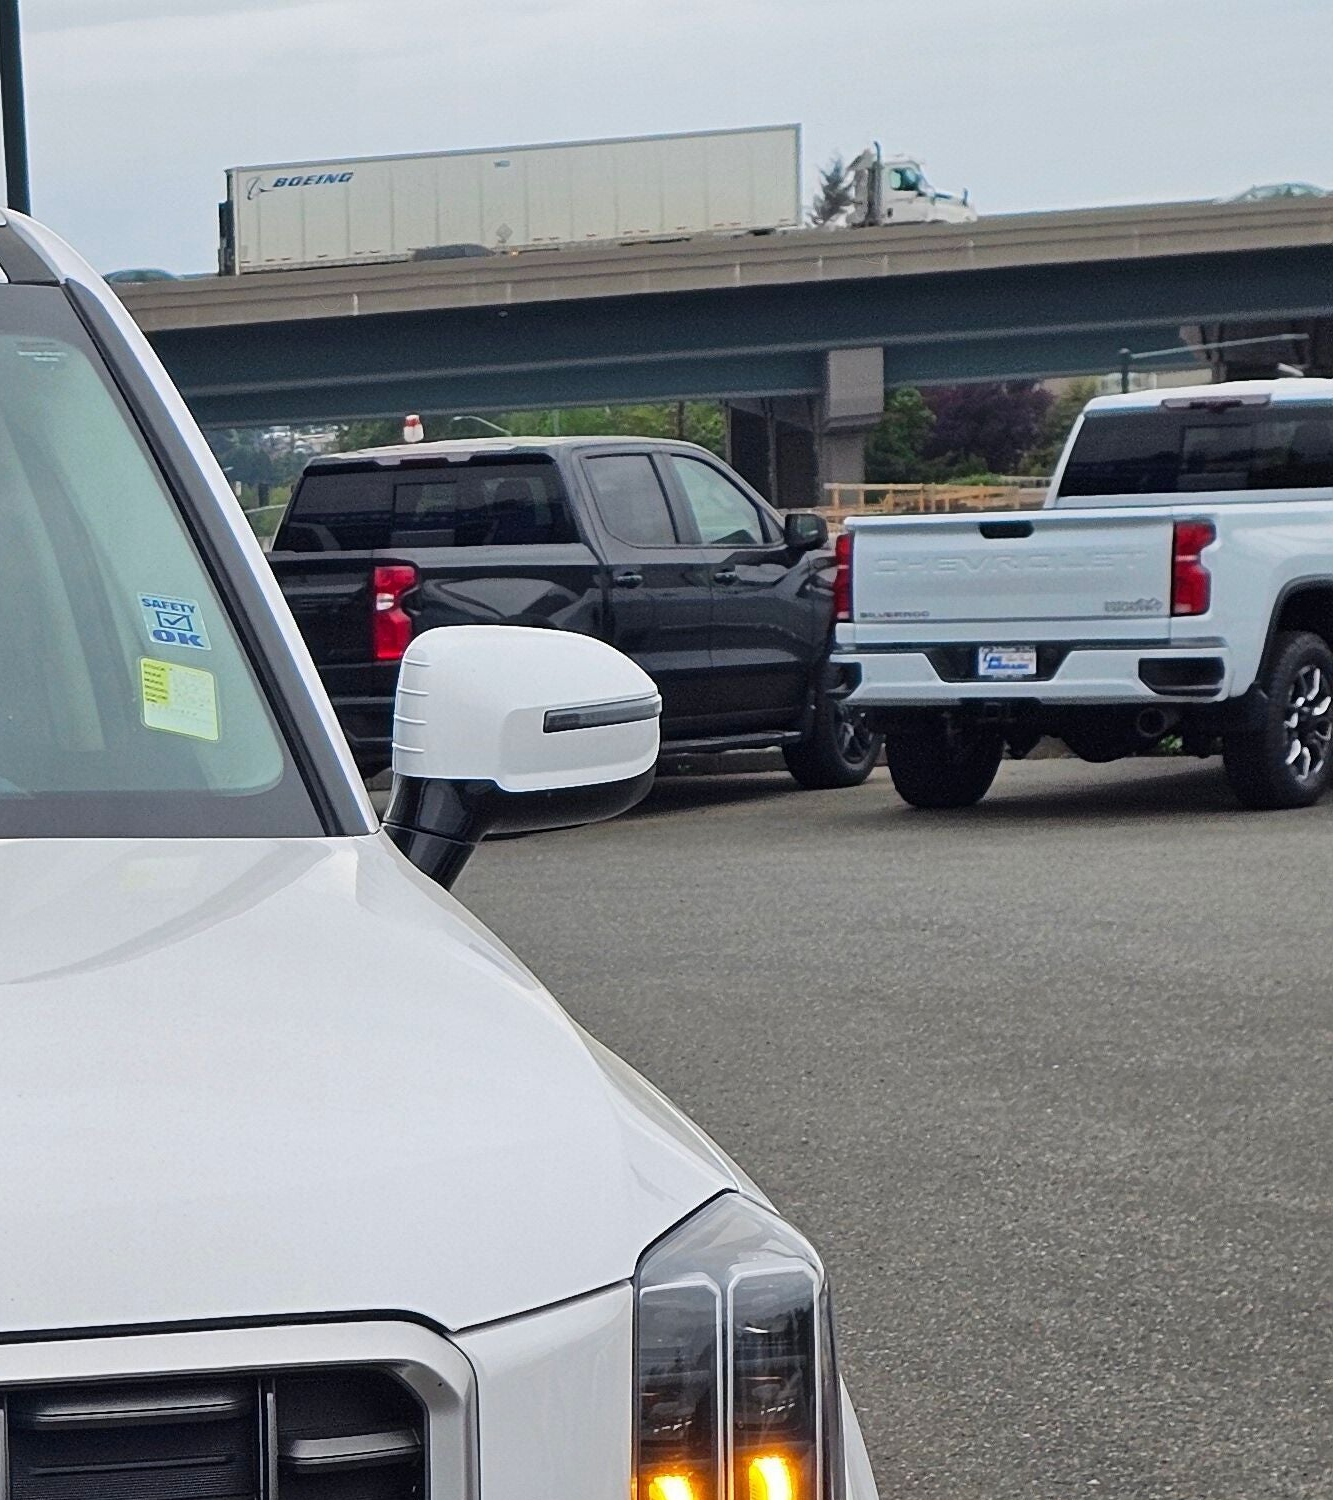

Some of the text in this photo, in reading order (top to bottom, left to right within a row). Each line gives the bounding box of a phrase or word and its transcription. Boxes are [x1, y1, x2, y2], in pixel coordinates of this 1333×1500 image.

[272, 171, 354, 188] BOEING
[873, 551, 1148, 575] CHEVROLET
[141, 597, 195, 614] SAFETY
[152, 629, 205, 648] OK
